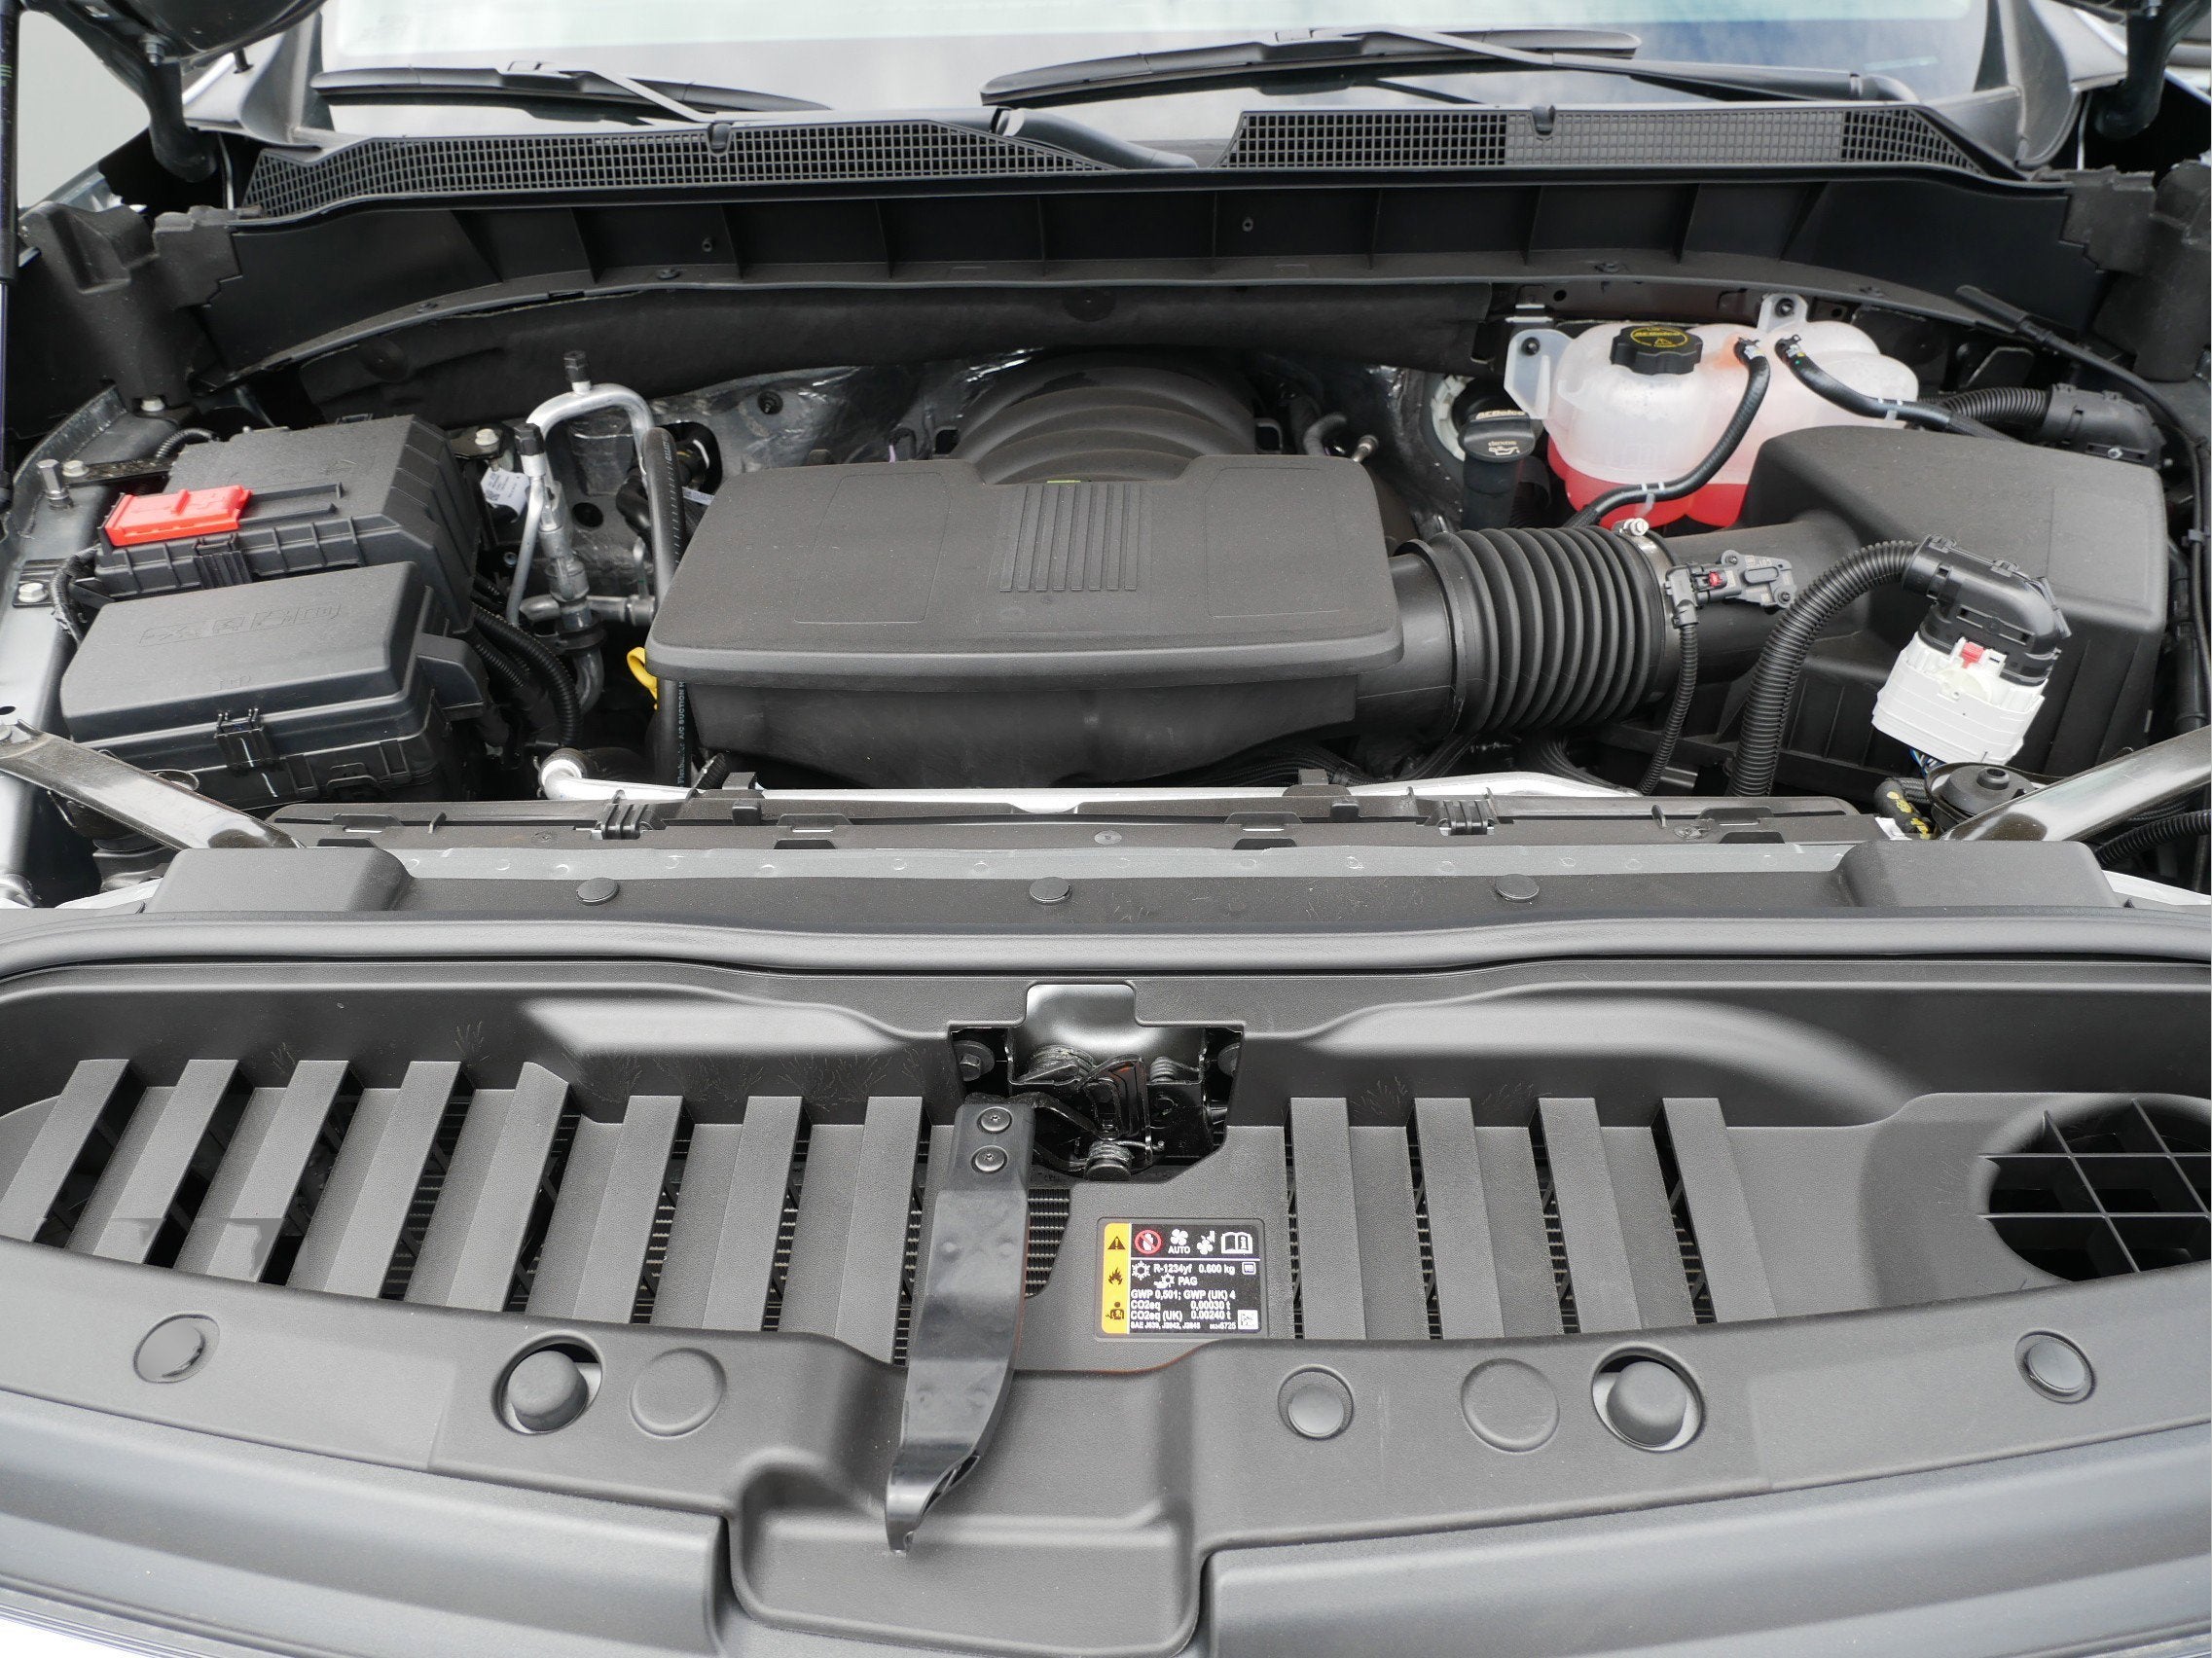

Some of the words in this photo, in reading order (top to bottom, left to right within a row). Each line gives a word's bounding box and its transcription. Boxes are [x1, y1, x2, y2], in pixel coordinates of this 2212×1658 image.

[1475, 410, 1526, 419] ACDelco
[1168, 1245, 1190, 1254] AUTO
[1153, 1263, 1192, 1275] R-1234yf
[1223, 1263, 1235, 1276] kg
[1178, 1276, 1198, 1285] PAG
[1130, 1289, 1153, 1299] GWP
[1182, 1290, 1206, 1299] GWP
[1208, 1290, 1228, 1301] (UK)
[1229, 1290, 1236, 1299] 4
[1130, 1300, 1161, 1311] CO2eq
[1226, 1301, 1231, 1310] t
[1130, 1311, 1161, 1321] CO2eq
[1163, 1311, 1183, 1321] (UK)
[1226, 1311, 1231, 1319] t
